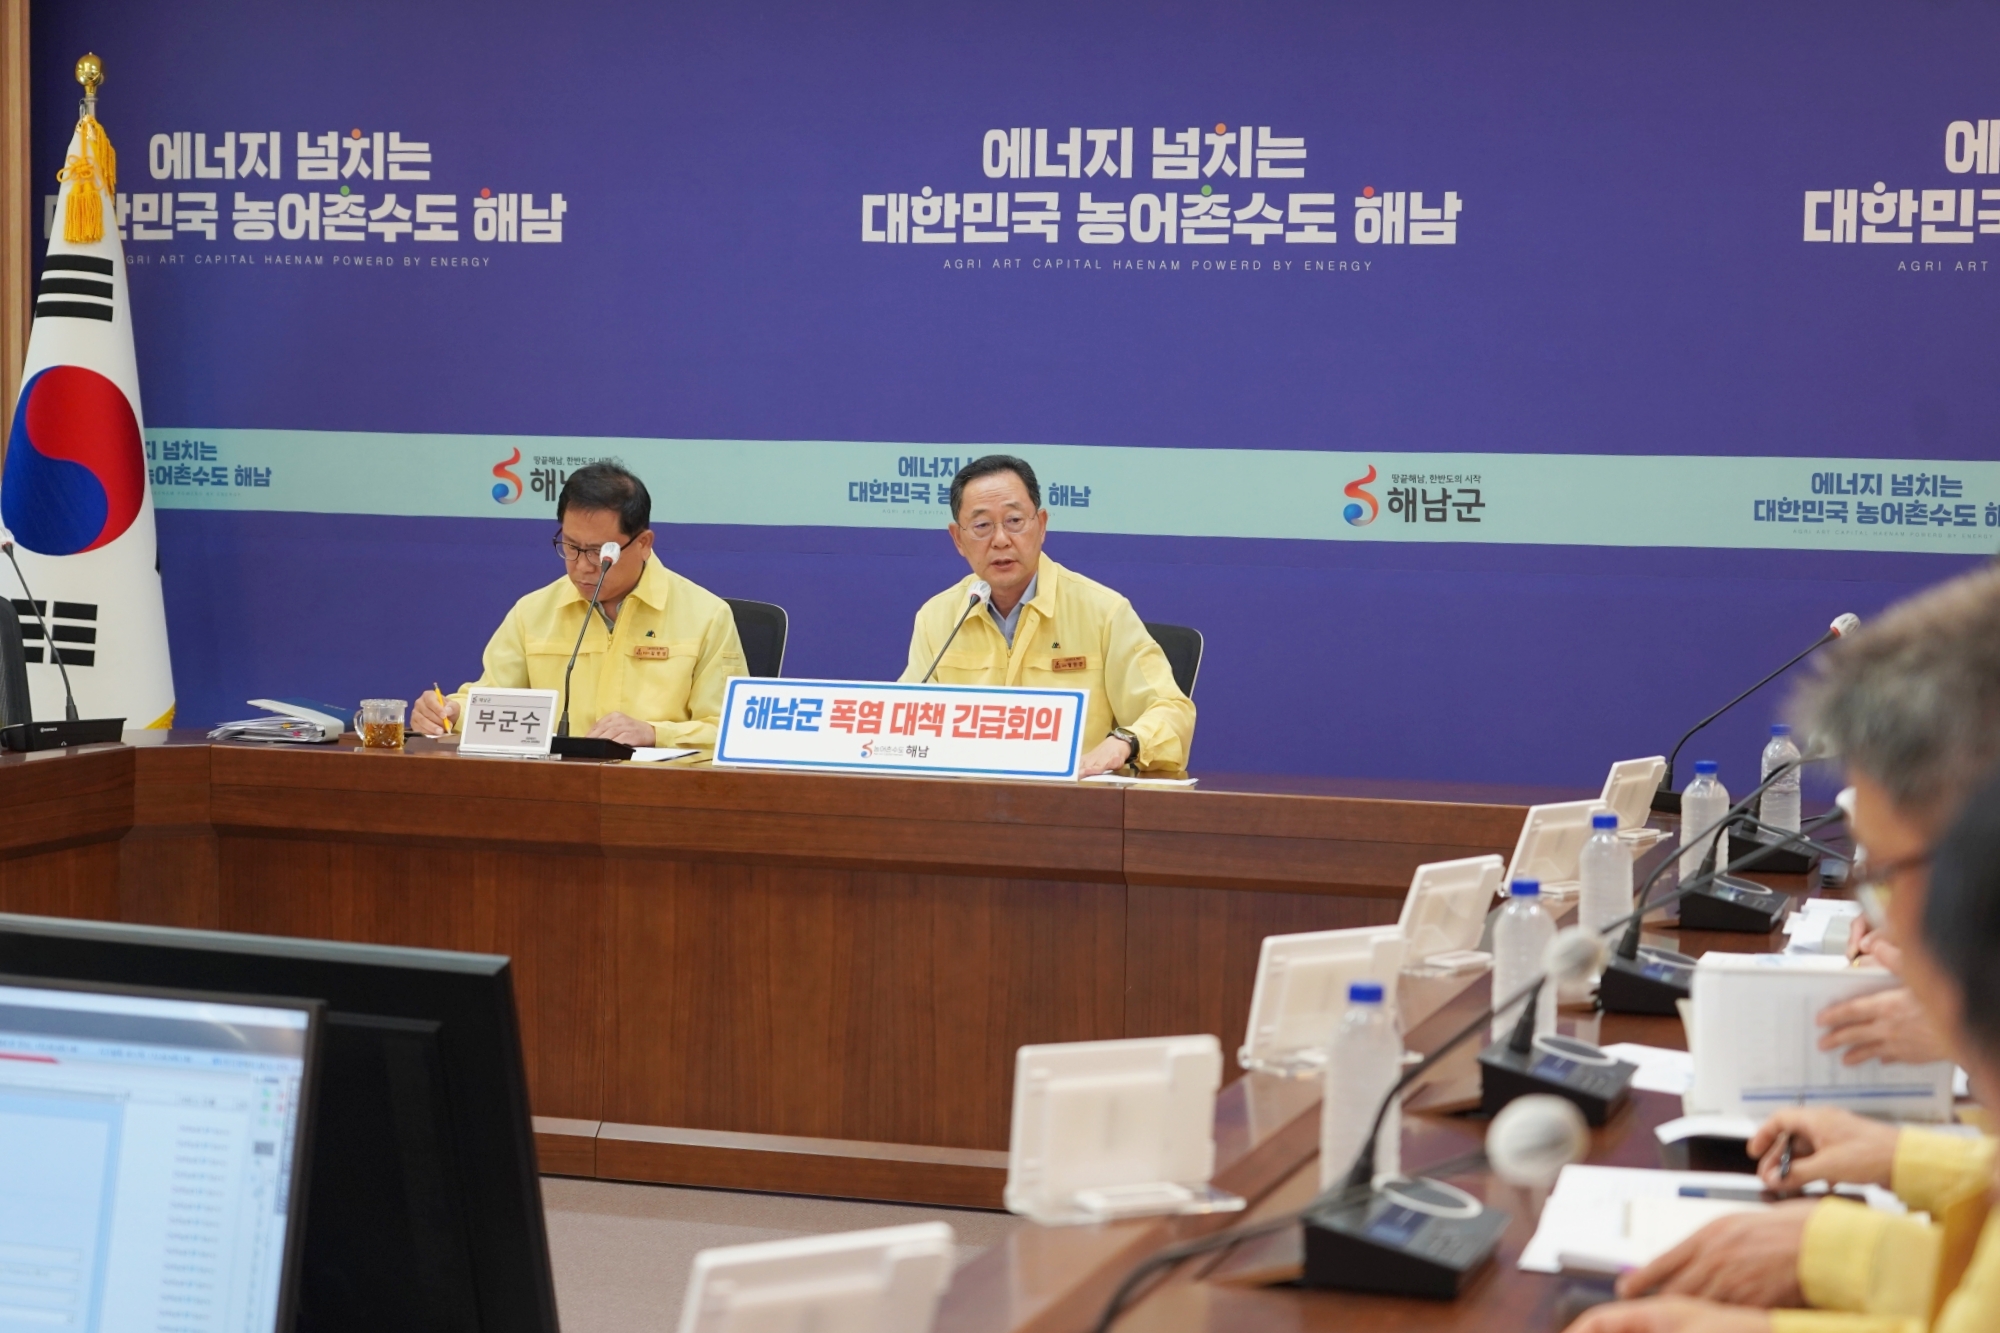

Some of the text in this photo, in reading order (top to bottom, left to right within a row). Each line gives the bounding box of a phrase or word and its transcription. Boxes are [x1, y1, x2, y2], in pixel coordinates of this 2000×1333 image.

[150, 130, 432, 181] 에너지 넘치는
[982, 124, 1306, 179] 에너지 넘치는
[232, 186, 458, 242] 농어촌수도
[474, 188, 568, 243] 해남
[862, 185, 1462, 245] 대한민국 농어촌수도 해남
[126, 254, 490, 268] GRI ART CAPITAL HAENAM POWERD BY ENERGY
[943, 258, 1373, 272] AGRI ART CAPITAL HAENAM POWERD BY ENERGY
[1897, 260, 1988, 272] AGRI ART
[162, 439, 218, 461] 넘치는
[234, 464, 272, 487] 해남
[898, 456, 960, 478] 에너지
[1391, 473, 1482, 485] 땅끝해남, 한반도의 시작
[848, 479, 930, 504] 대한민국
[1048, 482, 1092, 507] 해남
[1811, 472, 1963, 498] 에너지 넘치는
[1387, 487, 1485, 523] 해남군
[1754, 496, 1849, 523] 대한민국
[1856, 499, 1978, 528] 농어촌수도
[475, 709, 541, 734] 부군수
[743, 695, 1063, 742] 해남군 폭염 대책 긴급회의
[905, 745, 930, 759] 해남
